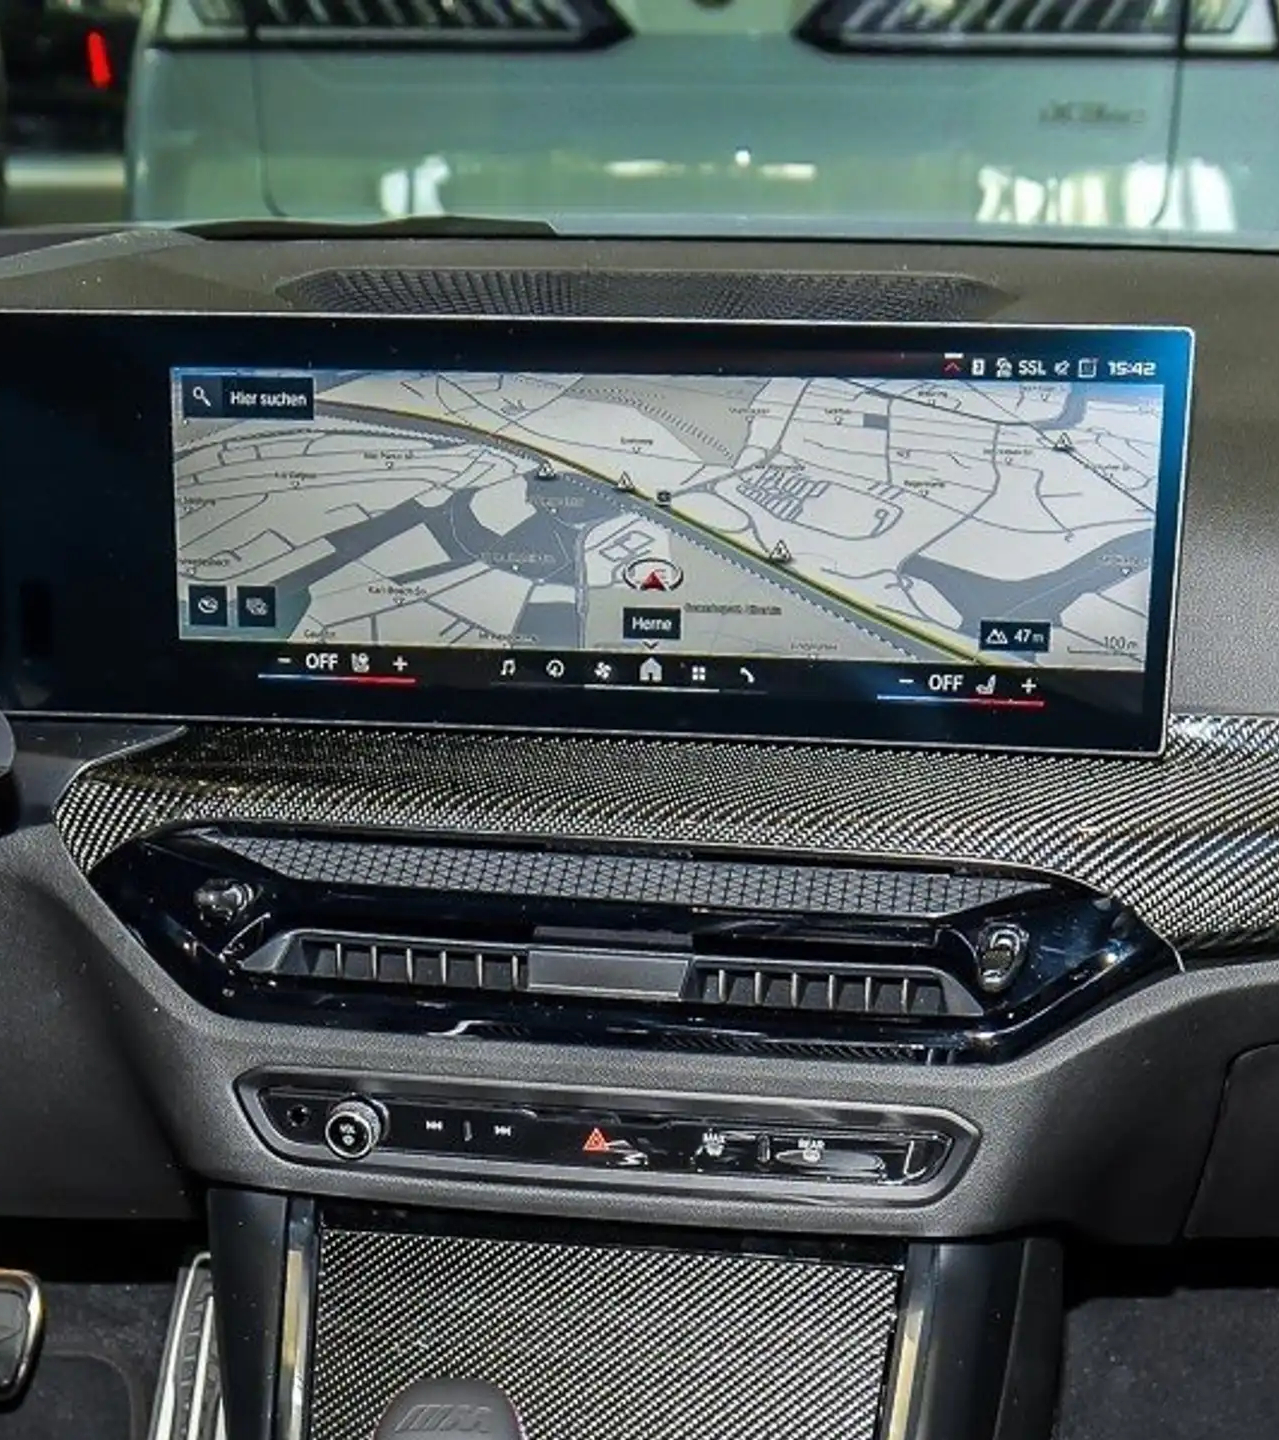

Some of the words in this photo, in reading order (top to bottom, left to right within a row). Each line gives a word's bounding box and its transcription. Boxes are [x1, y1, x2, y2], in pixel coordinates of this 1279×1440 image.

[1108, 360, 1156, 376] 15:42
[231, 391, 257, 405] Hier
[260, 392, 307, 406] suchen
[305, 653, 339, 670] OFF
[928, 674, 964, 691] OFF
